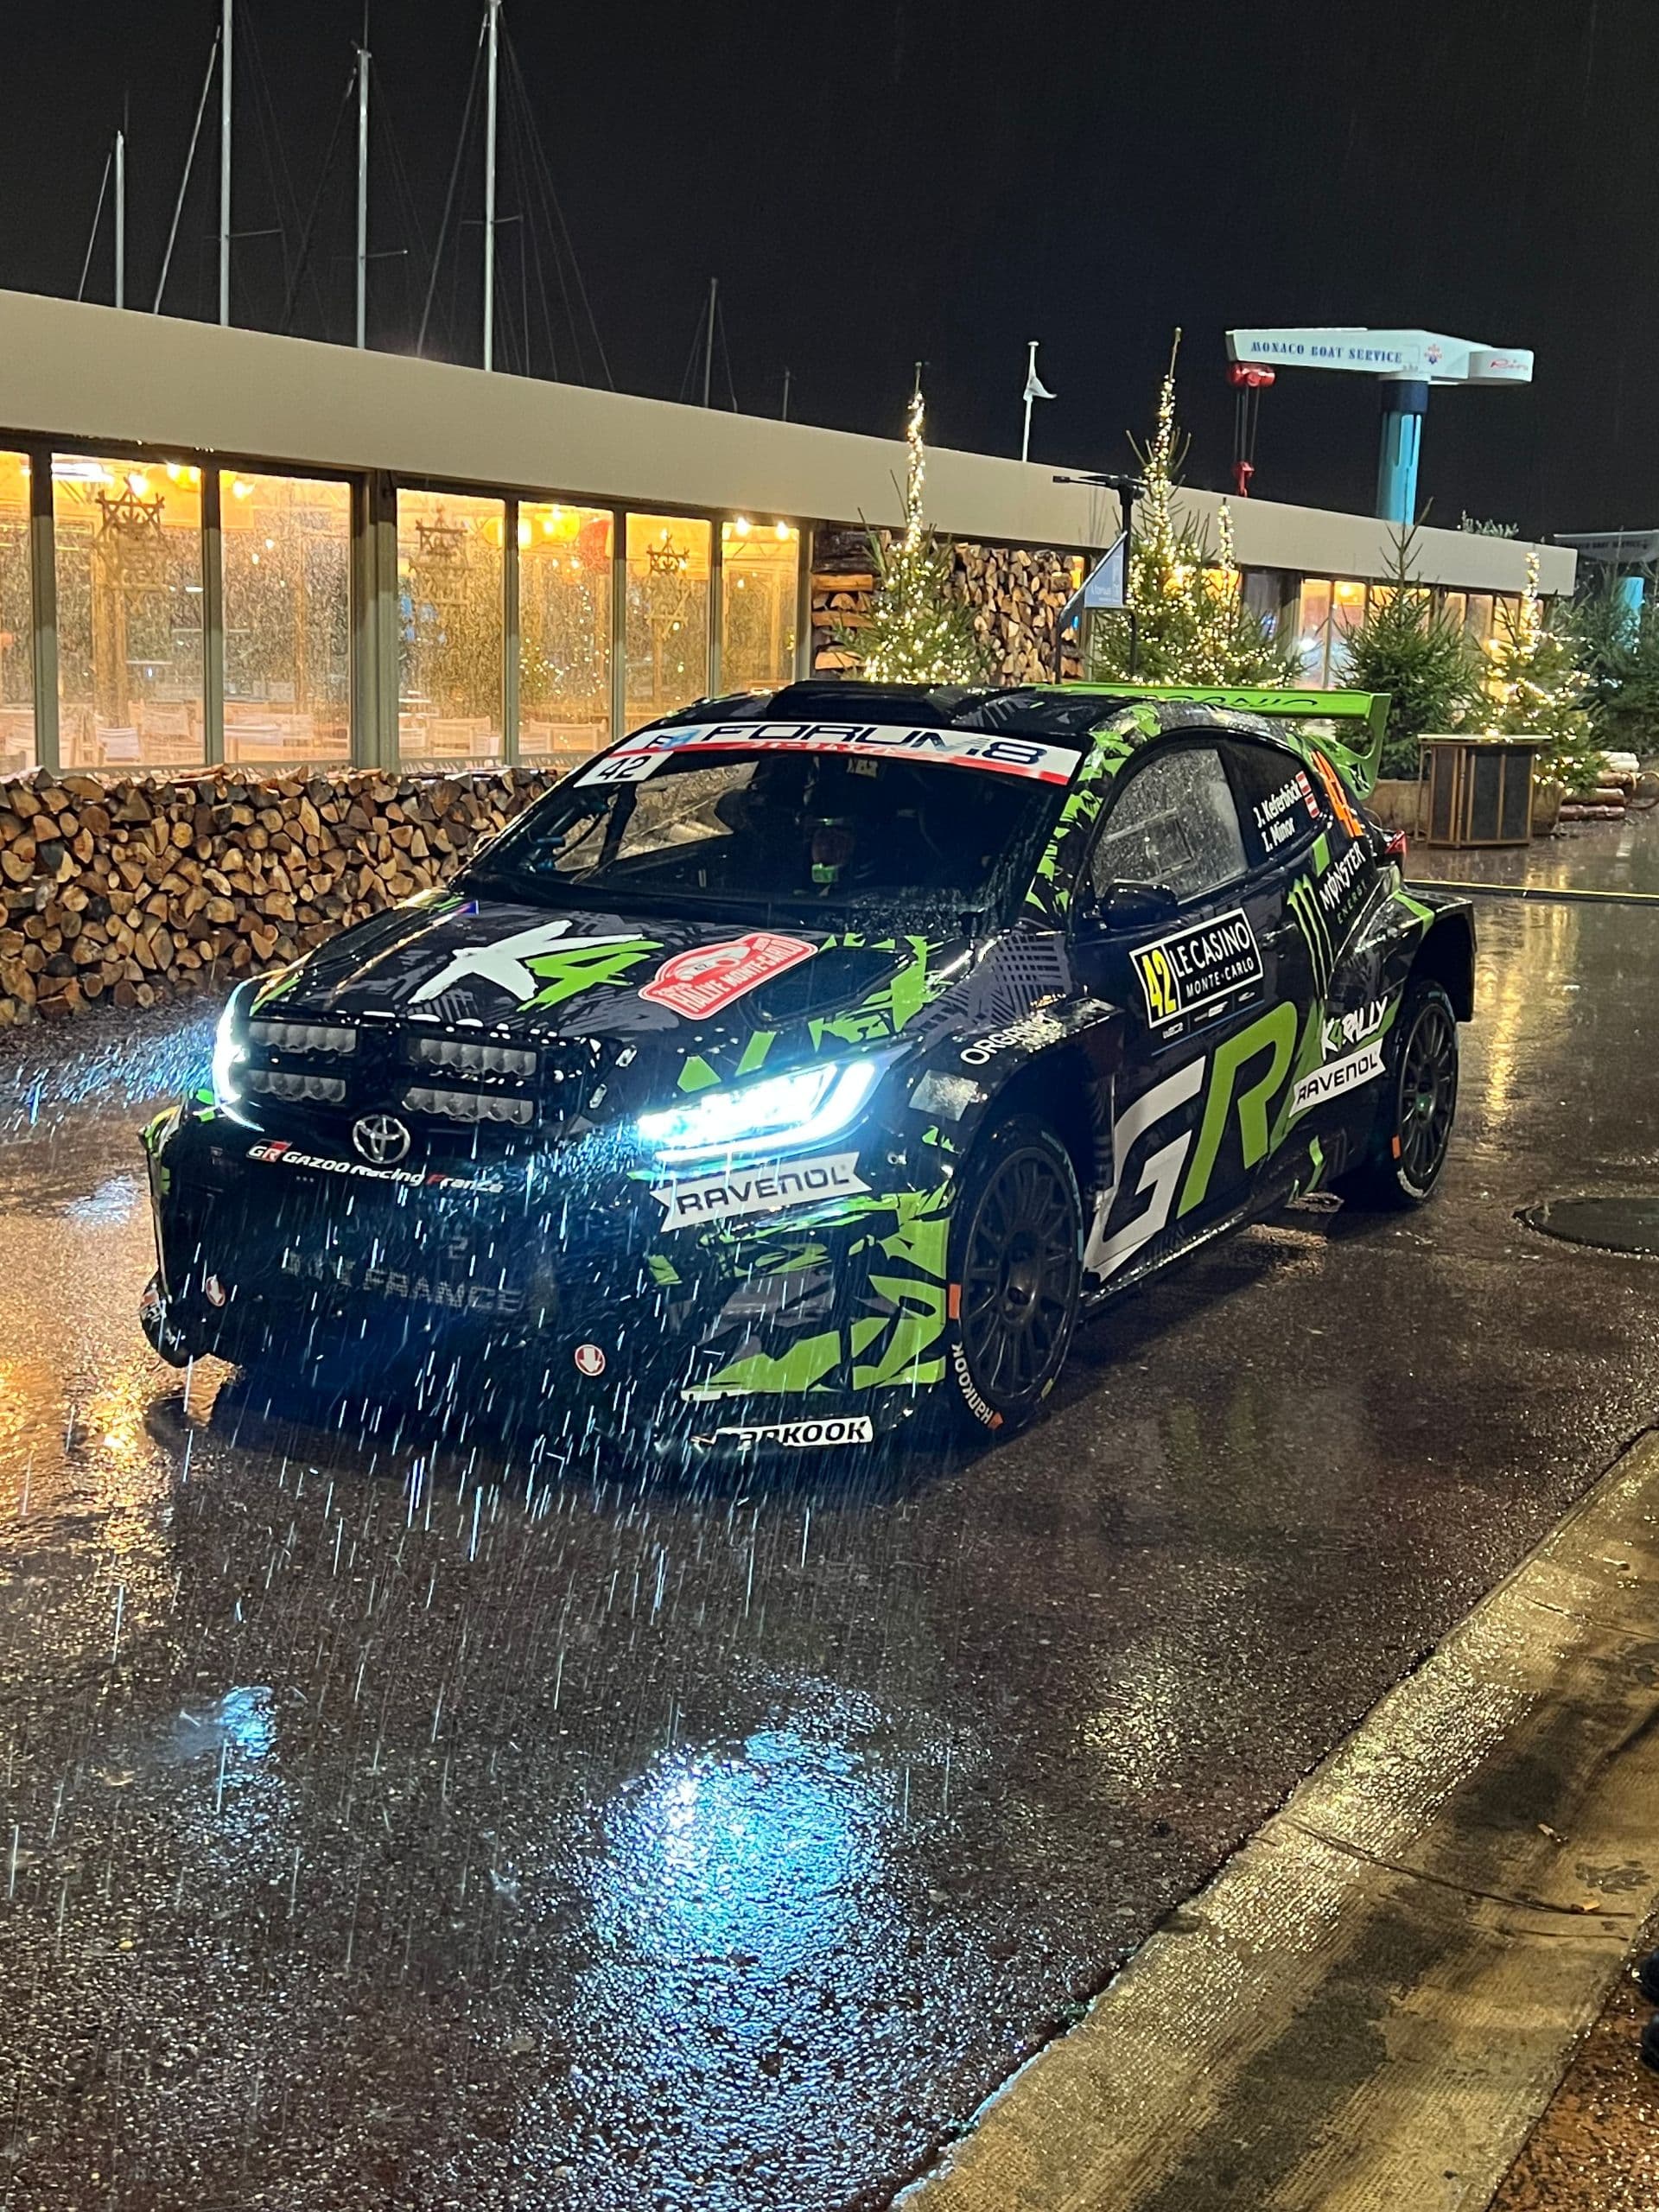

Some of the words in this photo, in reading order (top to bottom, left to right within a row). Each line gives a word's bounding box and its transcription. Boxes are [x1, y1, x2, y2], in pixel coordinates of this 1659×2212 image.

[1250, 341, 1305, 355] MONACO
[1311, 346, 1344, 358] BOAT
[1348, 348, 1402, 363] SERVICE
[597, 755, 652, 780] 42
[1253, 806, 1266, 828] J.
[1269, 817, 1295, 846] Minor
[1319, 841, 1366, 911] MONSTER
[1337, 879, 1368, 925] ENERGY
[407, 919, 664, 1013] K4
[1141, 949, 1177, 1018] 42
[1169, 945, 1194, 978] LE
[1190, 921, 1251, 969] CASINO
[663, 980, 731, 1013] RALLYE
[1297, 1054, 1378, 1104] RAVENOL
[1082, 1001, 1298, 1282] GR
[248, 1146, 281, 1161] GR
[282, 1150, 350, 1173] GAZOO
[350, 1165, 425, 1186] Racing
[677, 1166, 850, 1214] RAVENOL
